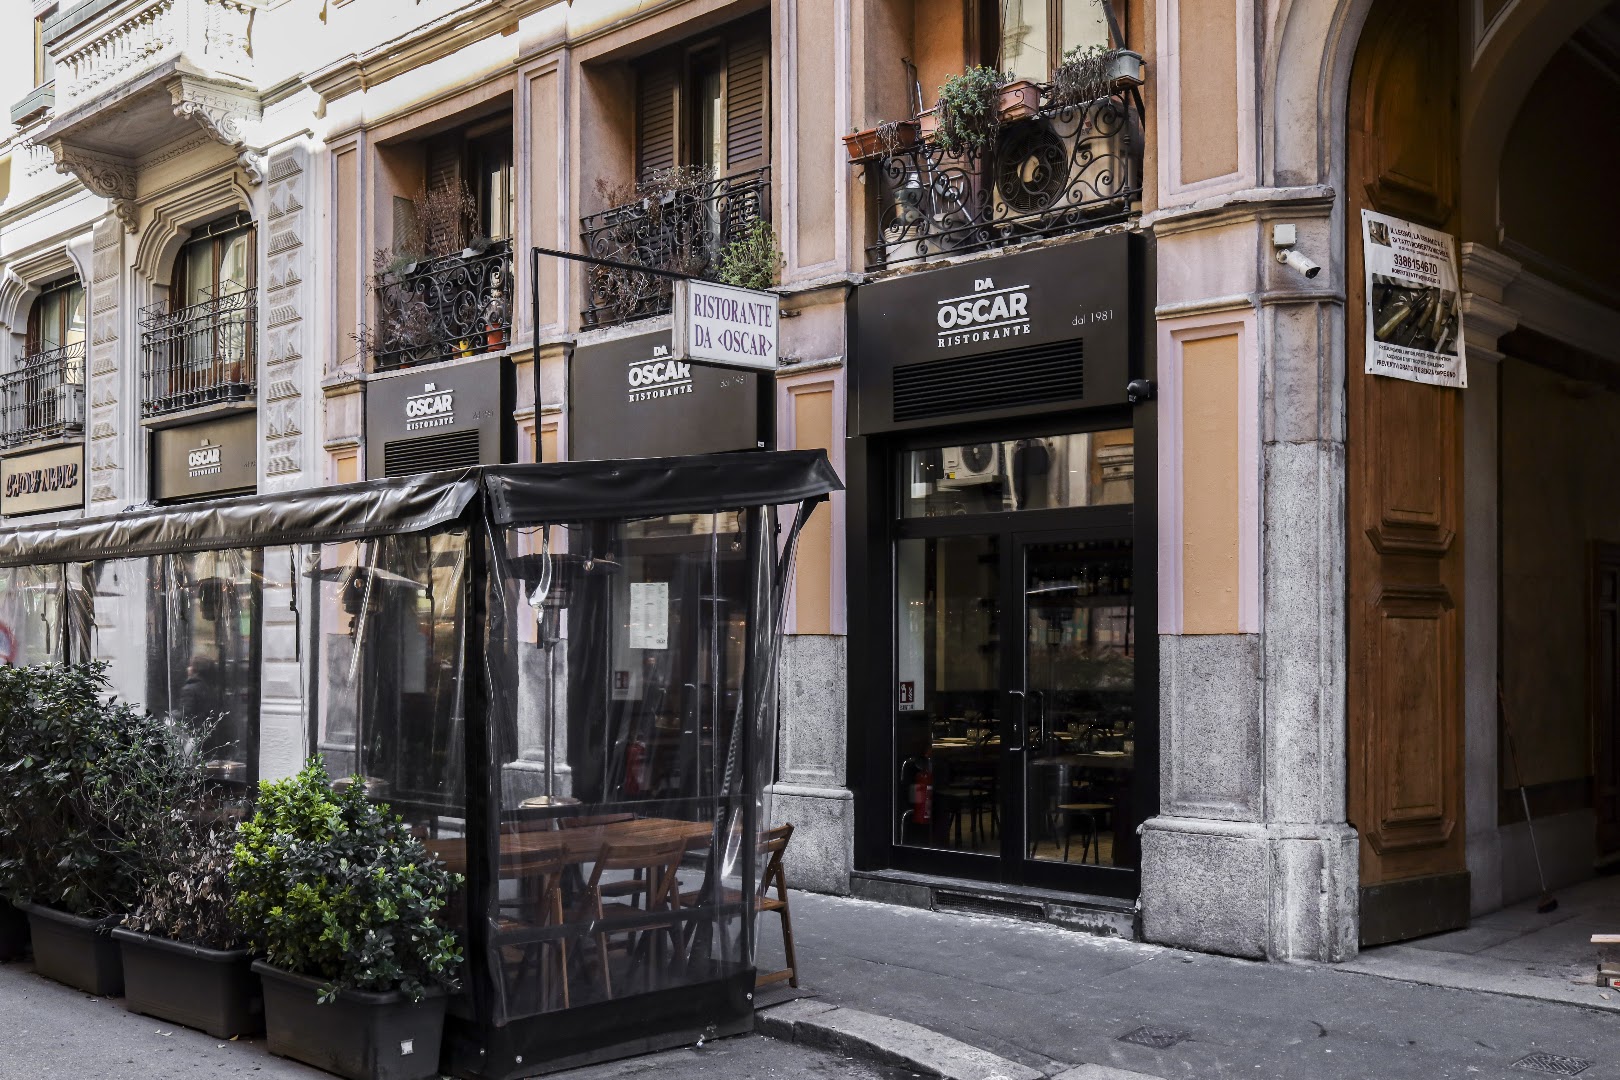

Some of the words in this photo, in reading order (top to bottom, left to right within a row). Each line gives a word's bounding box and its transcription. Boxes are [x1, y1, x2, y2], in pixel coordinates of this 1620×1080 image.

[1393, 253, 1438, 274] 3386154670
[974, 277, 994, 291] DA
[693, 292, 773, 327] RISTORANTE
[937, 292, 1028, 328] OSCAR
[1071, 314, 1086, 326] dal
[1090, 309, 1114, 323] 1981
[694, 324, 712, 349] DA
[937, 324, 1031, 348] RISTORANTE
[653, 344, 668, 357] DA
[628, 361, 691, 387] OSCAR
[628, 384, 693, 403] RISTORANTE
[406, 394, 453, 417] OSCAR
[406, 416, 454, 431] RISTORANTE
[189, 448, 221, 466] OSCAR
